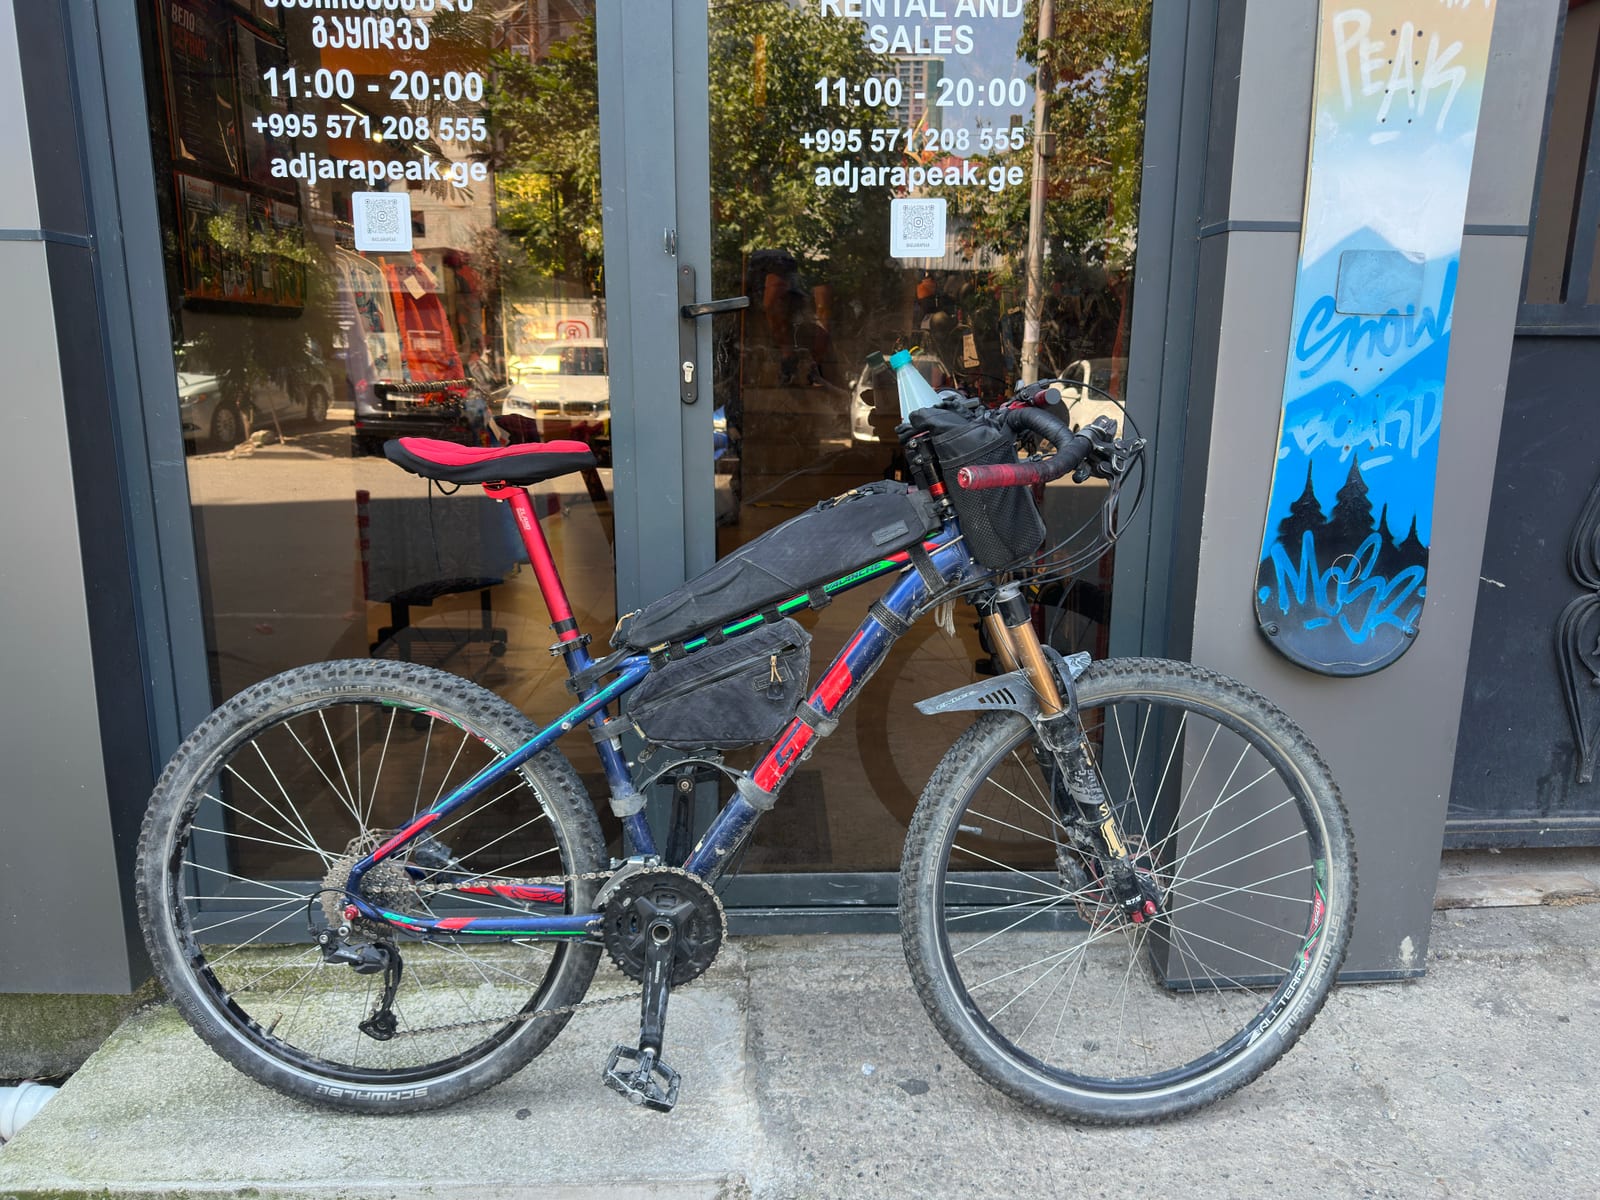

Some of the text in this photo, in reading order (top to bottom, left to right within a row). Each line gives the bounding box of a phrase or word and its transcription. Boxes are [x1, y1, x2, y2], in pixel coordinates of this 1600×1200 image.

[820, 0, 1024, 19] RENTAL AND
[312, 15, 430, 51] გაყიდვა
[868, 24, 974, 55] SALES
[263, 67, 483, 102] 11:00 - 20:00
[1333, 9, 1467, 132] PEAK
[814, 76, 1027, 107] 11:00 - 20:00
[251, 113, 487, 142] +995 571 208 555
[799, 127, 1025, 153] +995 571 208 555
[270, 154, 487, 189] adjarapeak.ge
[814, 161, 1024, 192] adjarapeak.ge
[1277, 914, 1343, 1041] SMART SAM PLUS
[314, 1083, 430, 1103] SCHWALBE
